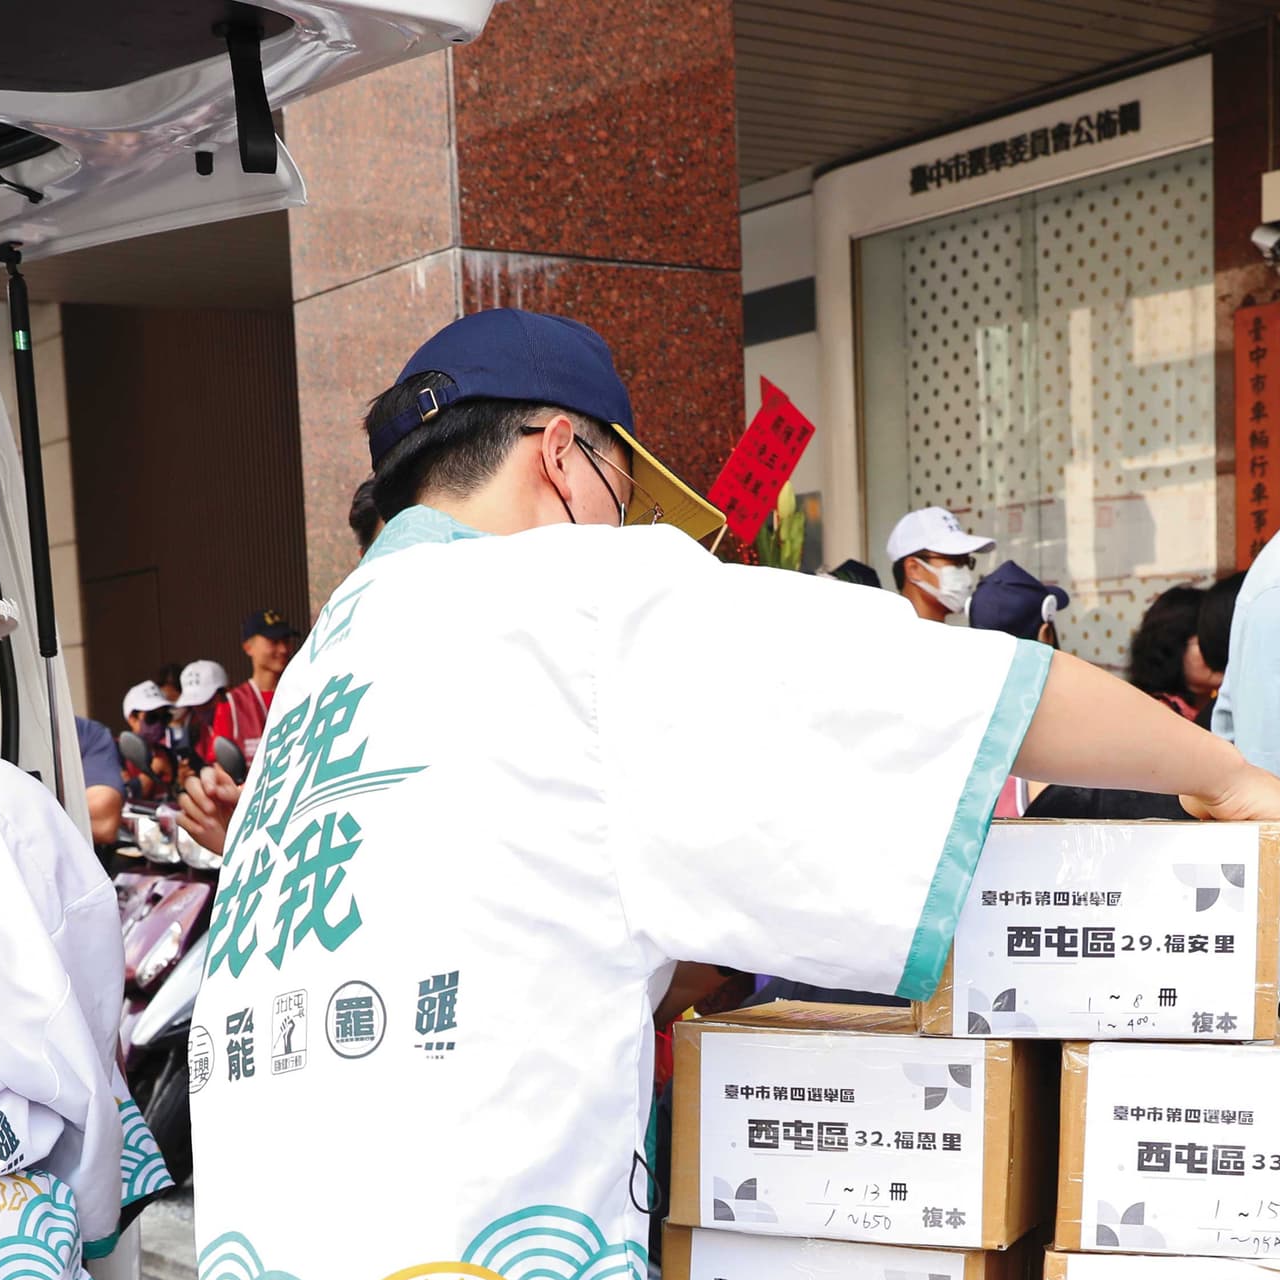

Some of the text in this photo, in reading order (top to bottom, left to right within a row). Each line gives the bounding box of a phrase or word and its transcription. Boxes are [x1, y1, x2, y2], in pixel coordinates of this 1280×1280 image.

[223, 672, 374, 867] 罷免
[208, 811, 363, 979] 找我
[982, 890, 1122, 907] 臺中市第四選舉區
[1192, 1012, 1237, 1033] 複本
[724, 1084, 855, 1103] 臺中市第四選舉區
[1114, 1105, 1254, 1126] 臺中市第四選舉區
[922, 1206, 966, 1229] 複本
